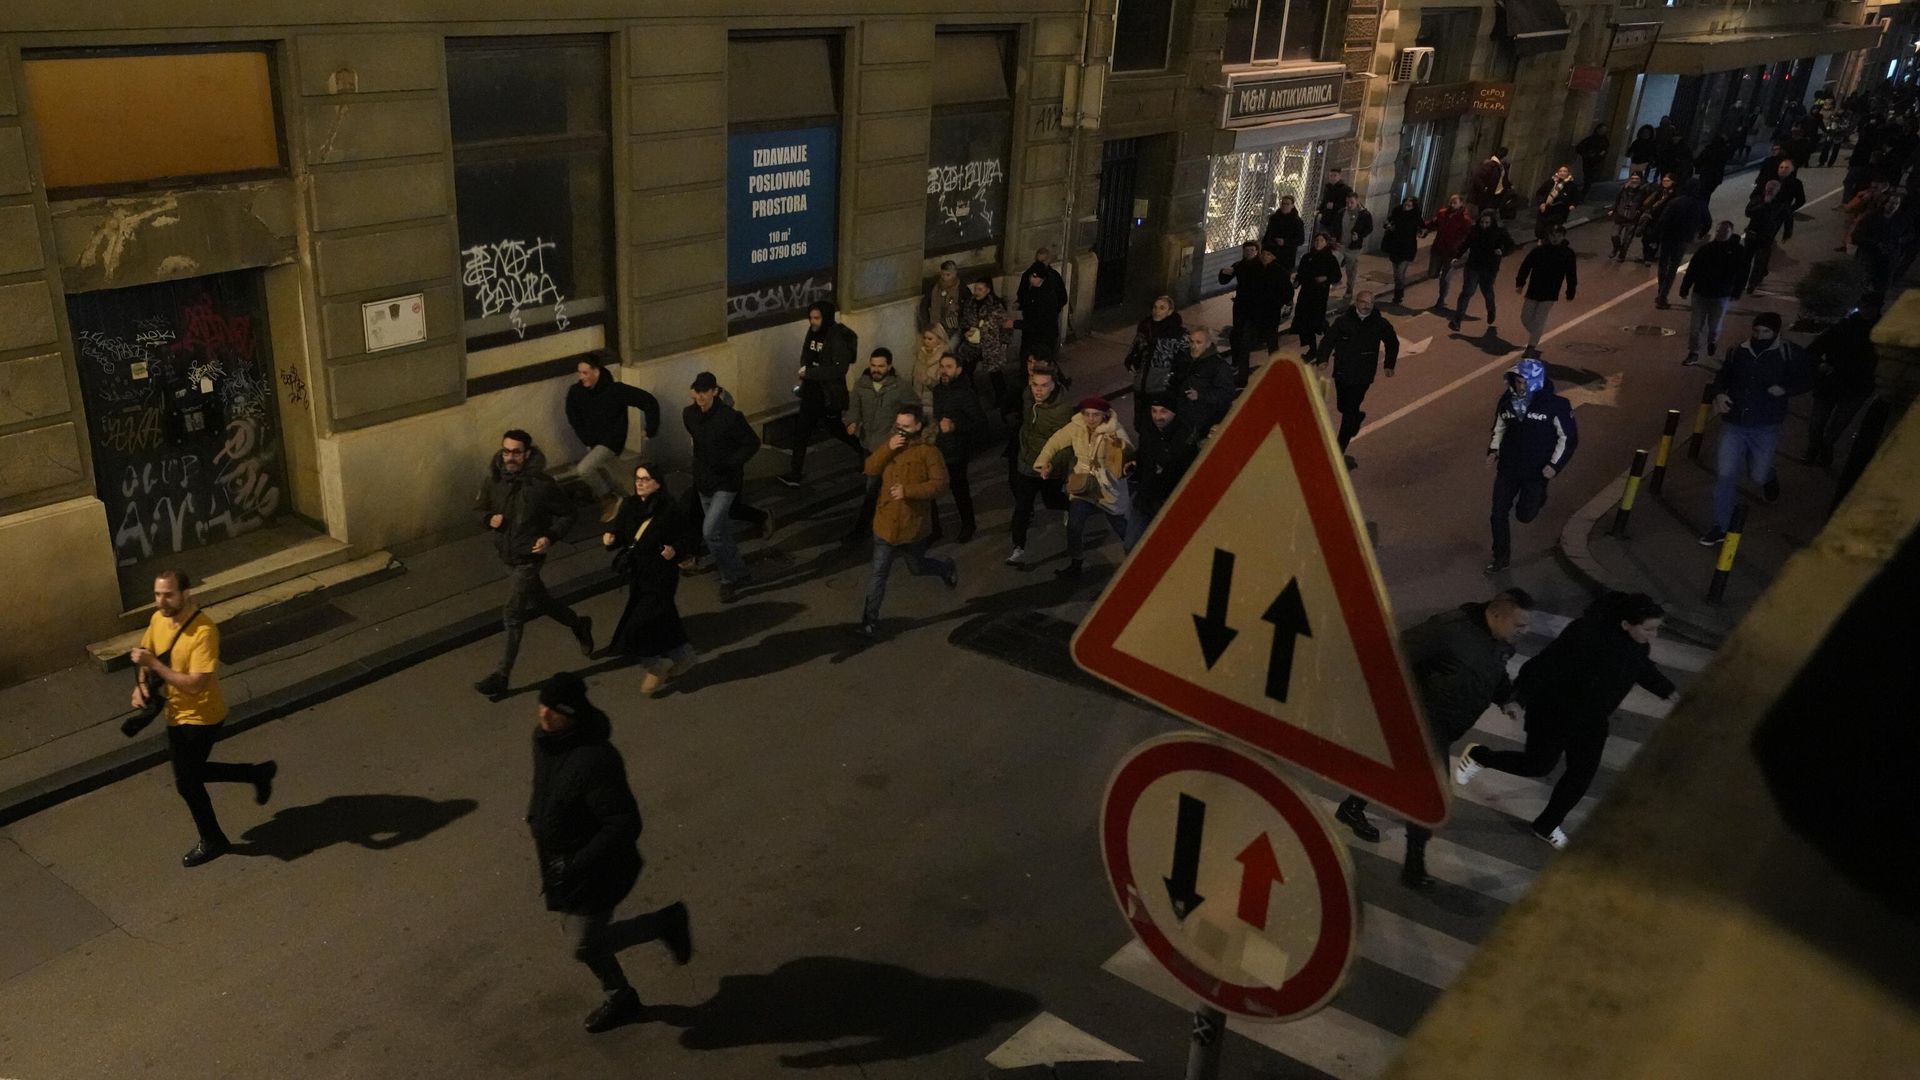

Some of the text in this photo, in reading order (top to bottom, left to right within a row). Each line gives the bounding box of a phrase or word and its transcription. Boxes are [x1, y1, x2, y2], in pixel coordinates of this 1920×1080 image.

[1239, 83, 1333, 113] M&N ANTIKVARNICA
[753, 144, 808, 168] IZDAVANJE
[748, 169, 811, 194] POSLOVNOG
[752, 194, 808, 218] PROSTORA
[768, 230, 780, 243] 110
[751, 242, 807, 264] 060 3790 856
